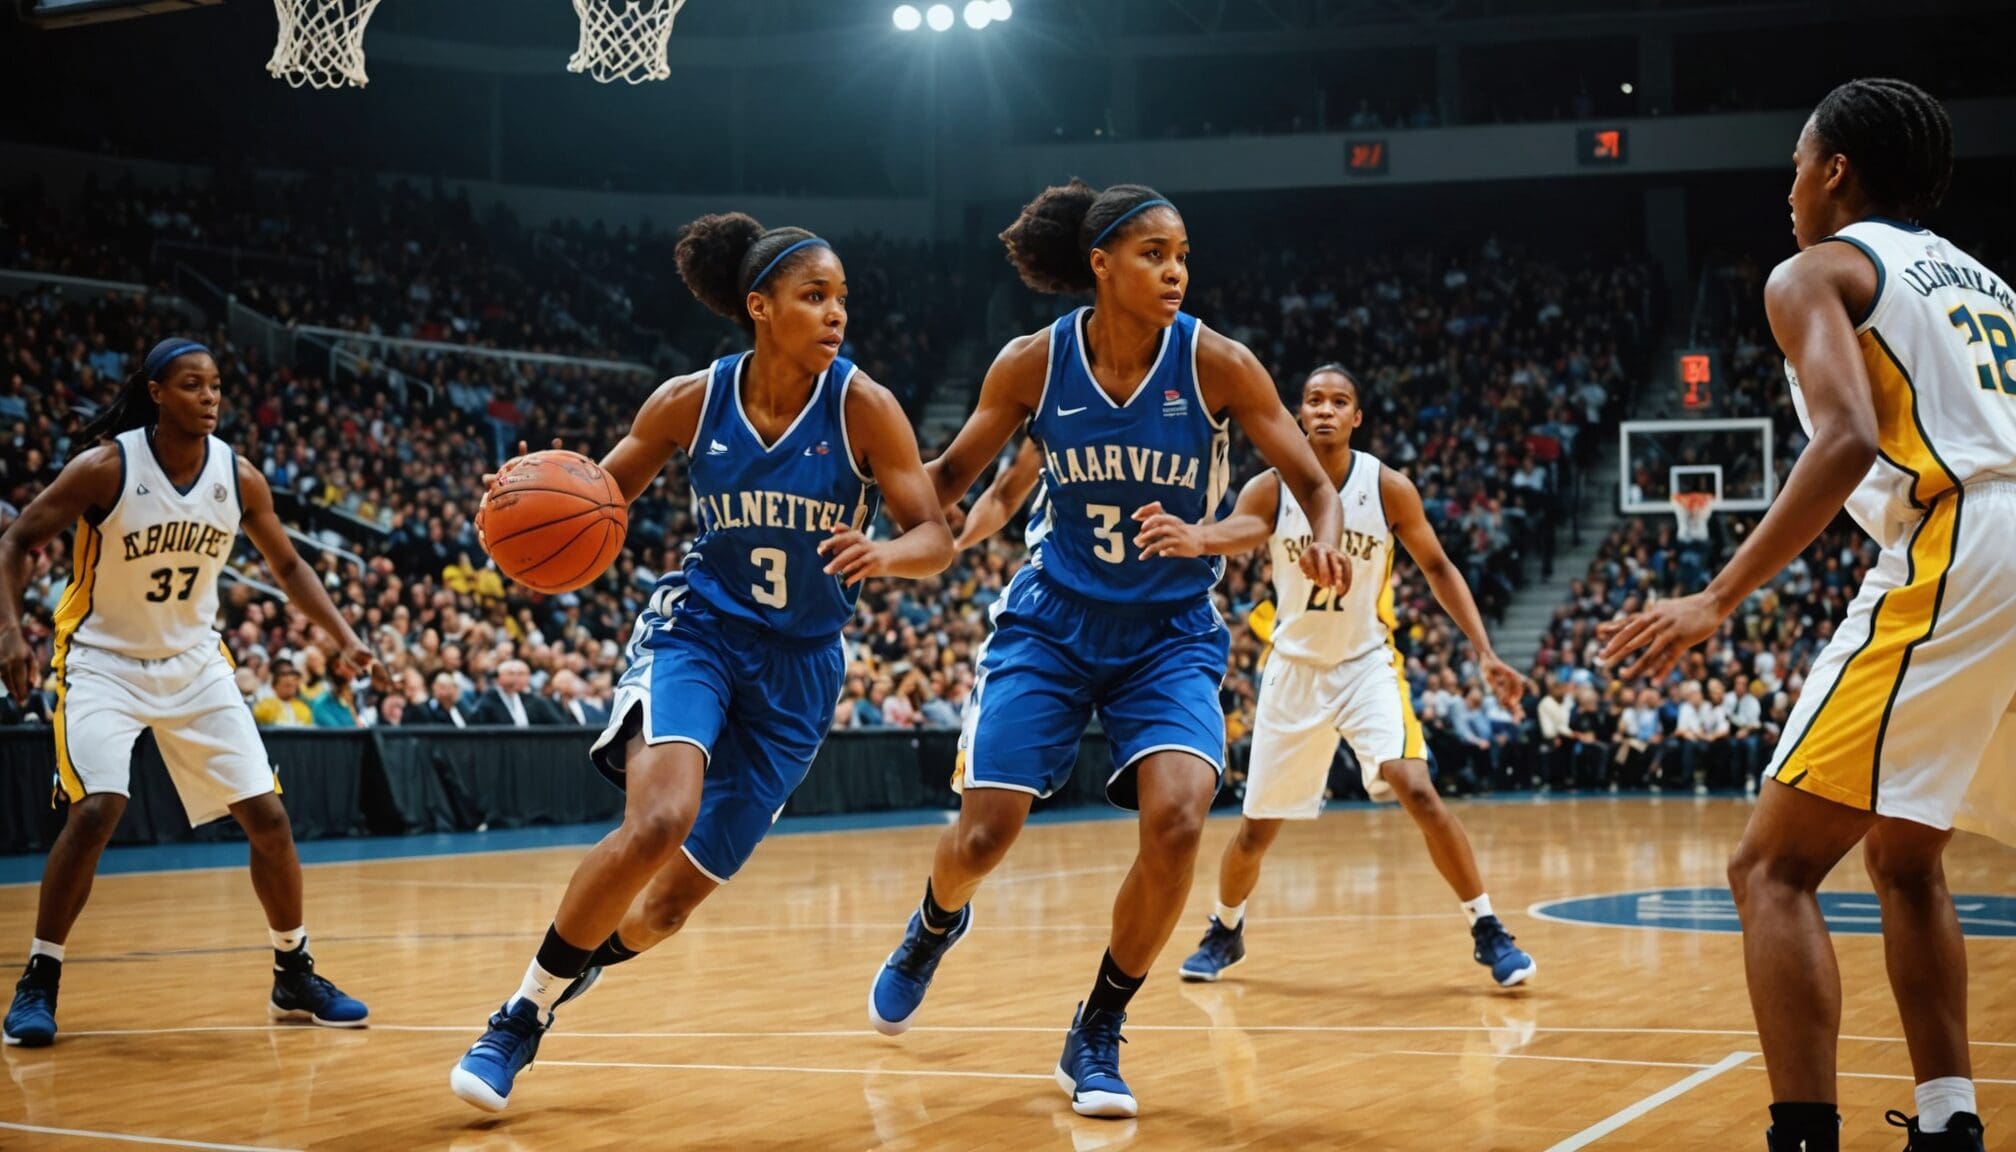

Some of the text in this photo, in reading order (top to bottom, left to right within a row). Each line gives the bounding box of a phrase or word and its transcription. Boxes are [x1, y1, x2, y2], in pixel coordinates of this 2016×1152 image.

[1086, 503, 1126, 564] 3
[146, 566, 200, 603] 37
[751, 547, 788, 610] 3
